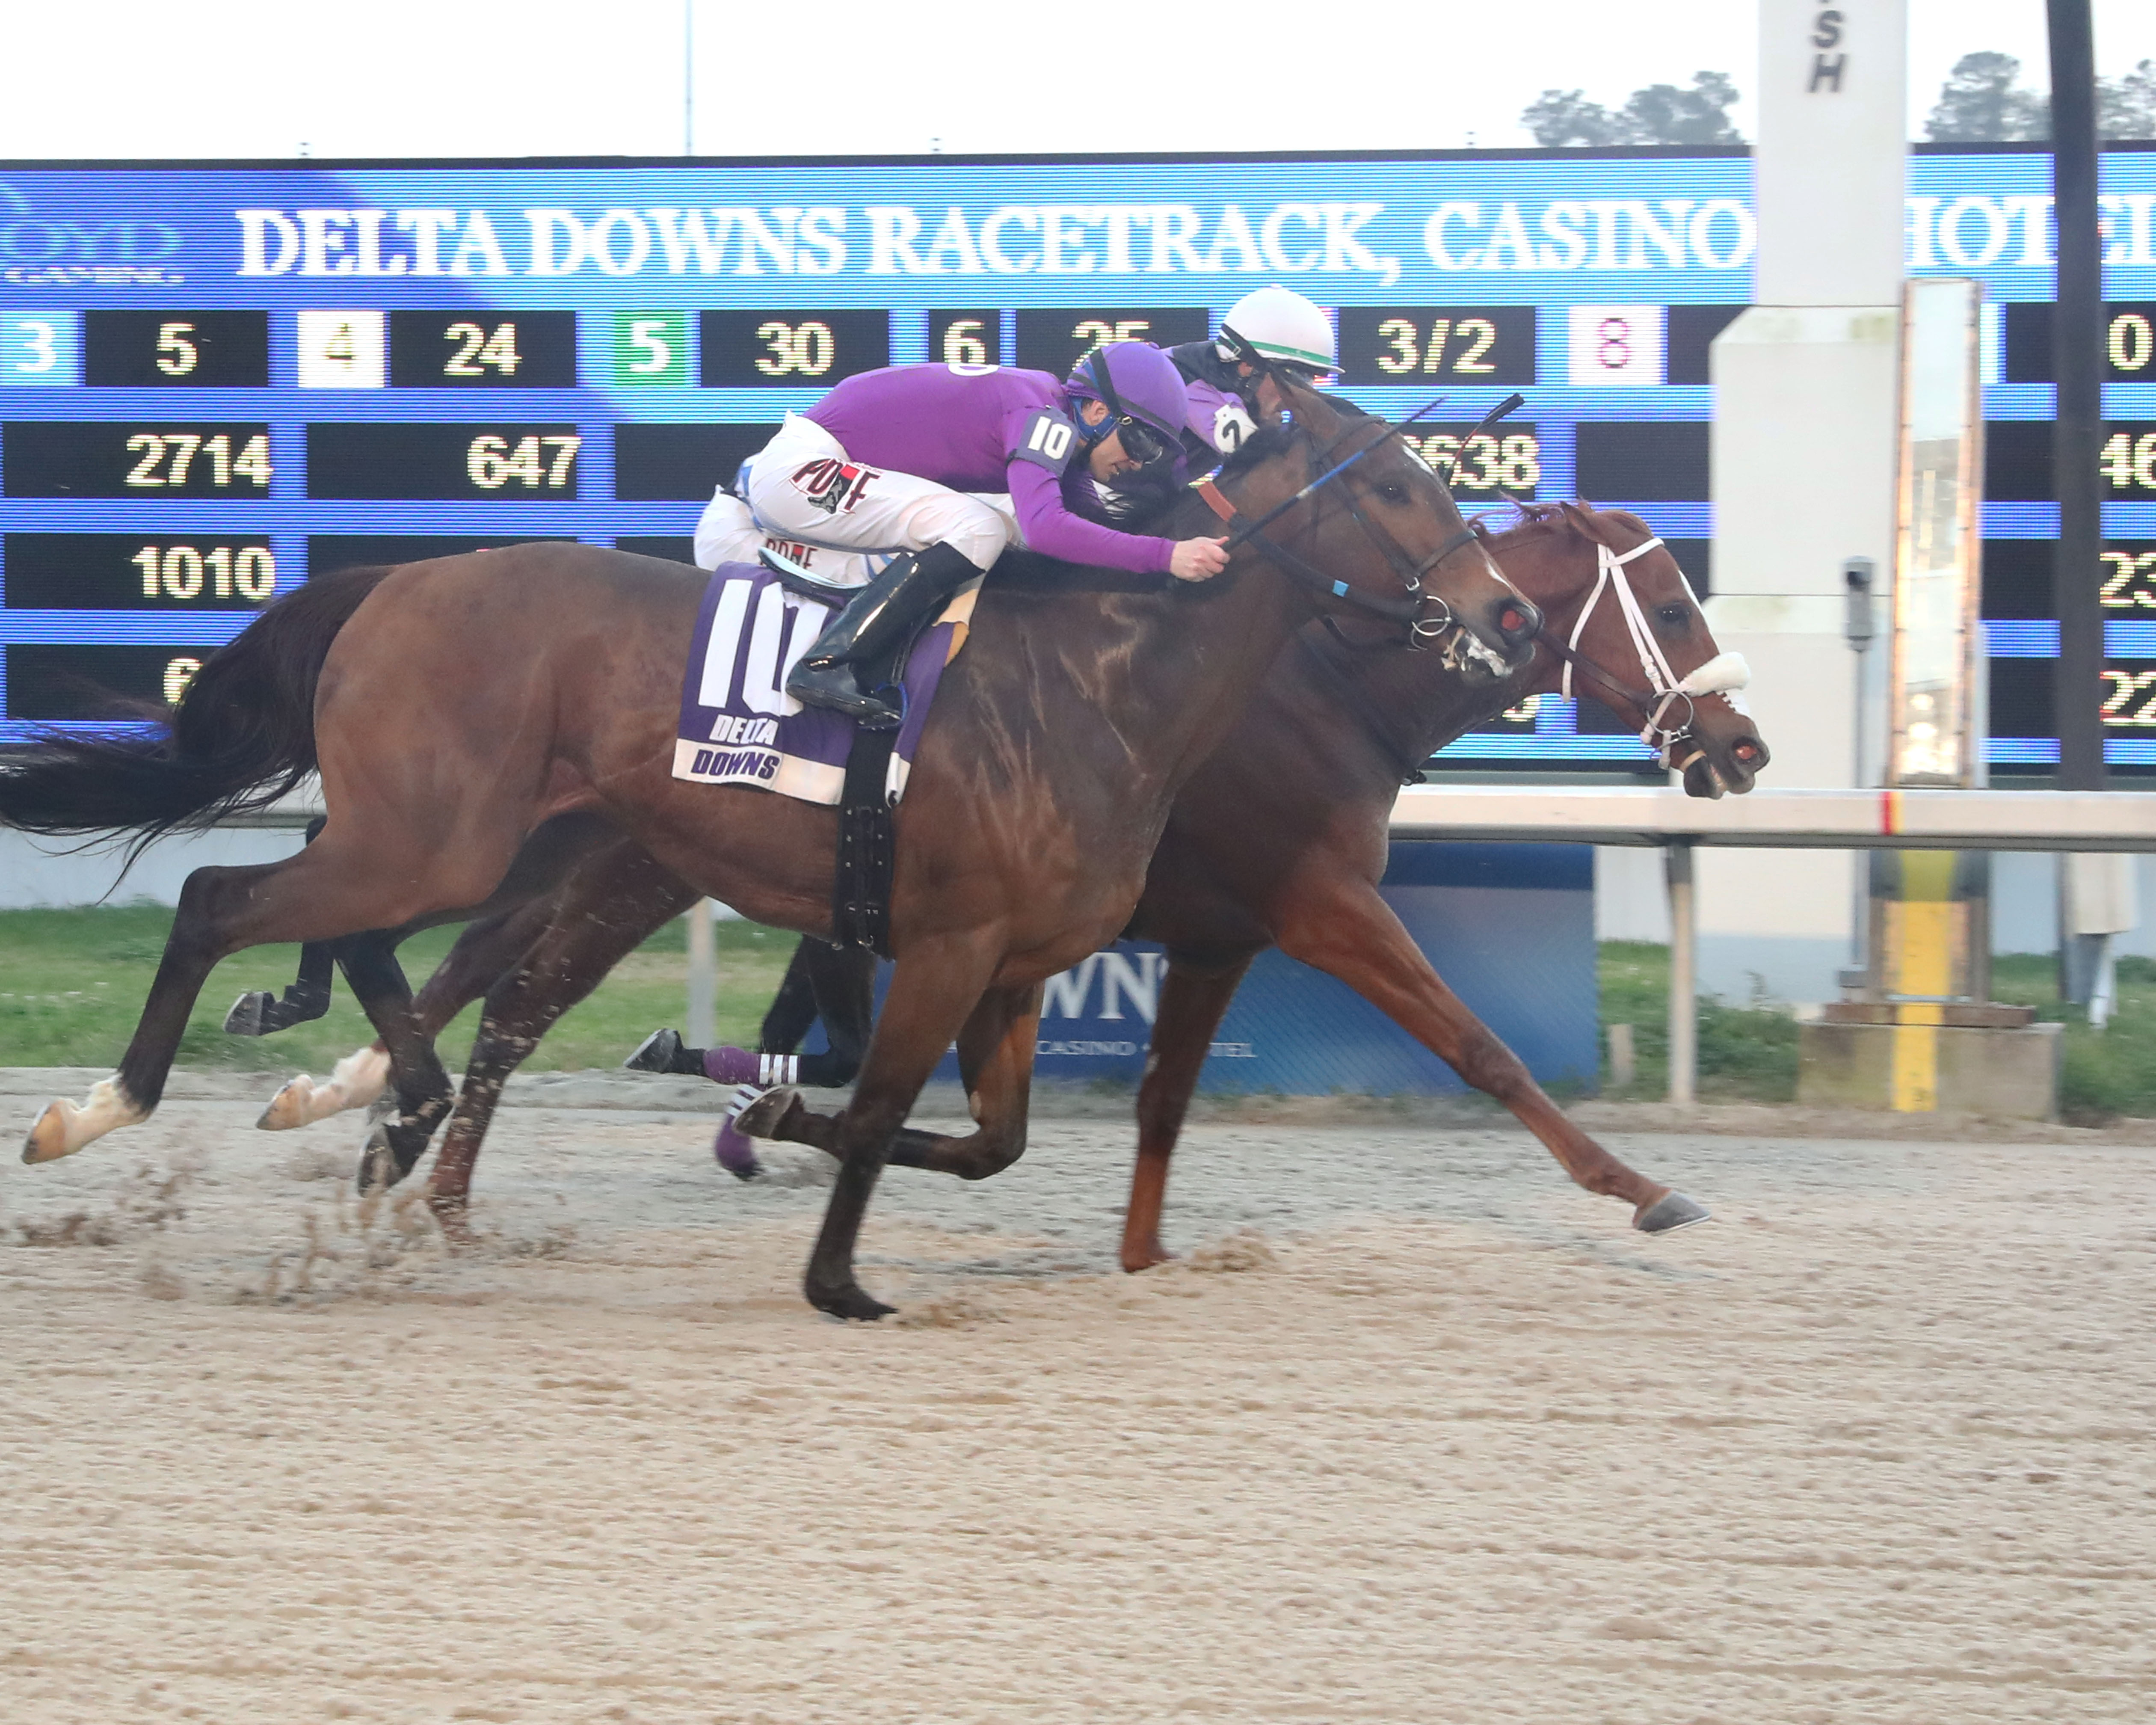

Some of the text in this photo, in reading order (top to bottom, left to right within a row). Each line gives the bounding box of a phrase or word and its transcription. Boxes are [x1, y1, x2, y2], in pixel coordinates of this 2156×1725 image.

[1803, 0, 1850, 94] SH
[235, 209, 511, 276] DELTA
[524, 207, 847, 275] DOWNS
[864, 204, 1401, 287] RACETRACK,
[1424, 199, 1757, 270] CASINO
[17, 322, 57, 371] 3
[156, 323, 197, 375] 5
[325, 323, 358, 371] 4
[444, 323, 522, 376] 24
[629, 321, 671, 374] 5
[755, 321, 835, 376] 30
[943, 320, 985, 365] 6
[1375, 318, 1497, 374] 3/2
[1597, 318, 1632, 368] 8
[124, 434, 273, 487] 2714
[468, 435, 582, 489] 647
[1028, 416, 1073, 460] 10
[1403, 435, 1540, 490] 638
[131, 546, 276, 598] 1010
[698, 579, 830, 718] 10
[708, 714, 779, 746] DELTA
[690, 749, 781, 780] DOWNS
